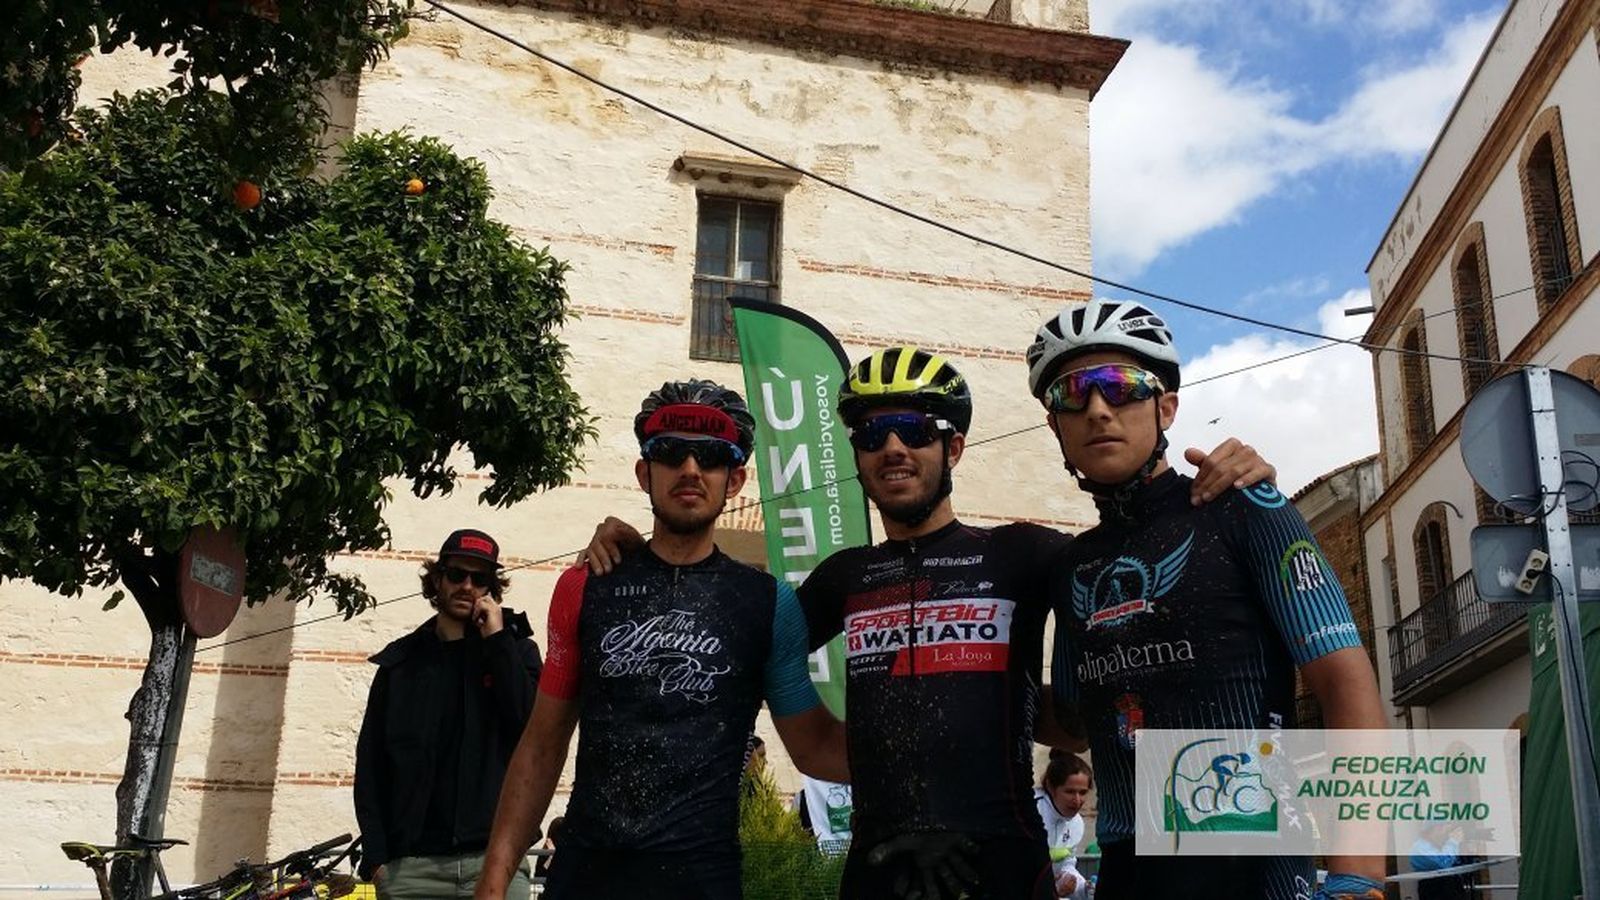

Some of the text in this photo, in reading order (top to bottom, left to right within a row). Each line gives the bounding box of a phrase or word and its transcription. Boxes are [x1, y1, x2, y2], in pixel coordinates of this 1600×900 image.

[1117, 316, 1145, 331] uvex
[662, 609, 697, 633] The
[601, 618, 723, 657] Agonia
[863, 622, 998, 648] WATIATO
[934, 646, 992, 664] La Joya
[1077, 639, 1196, 685] olipaterna
